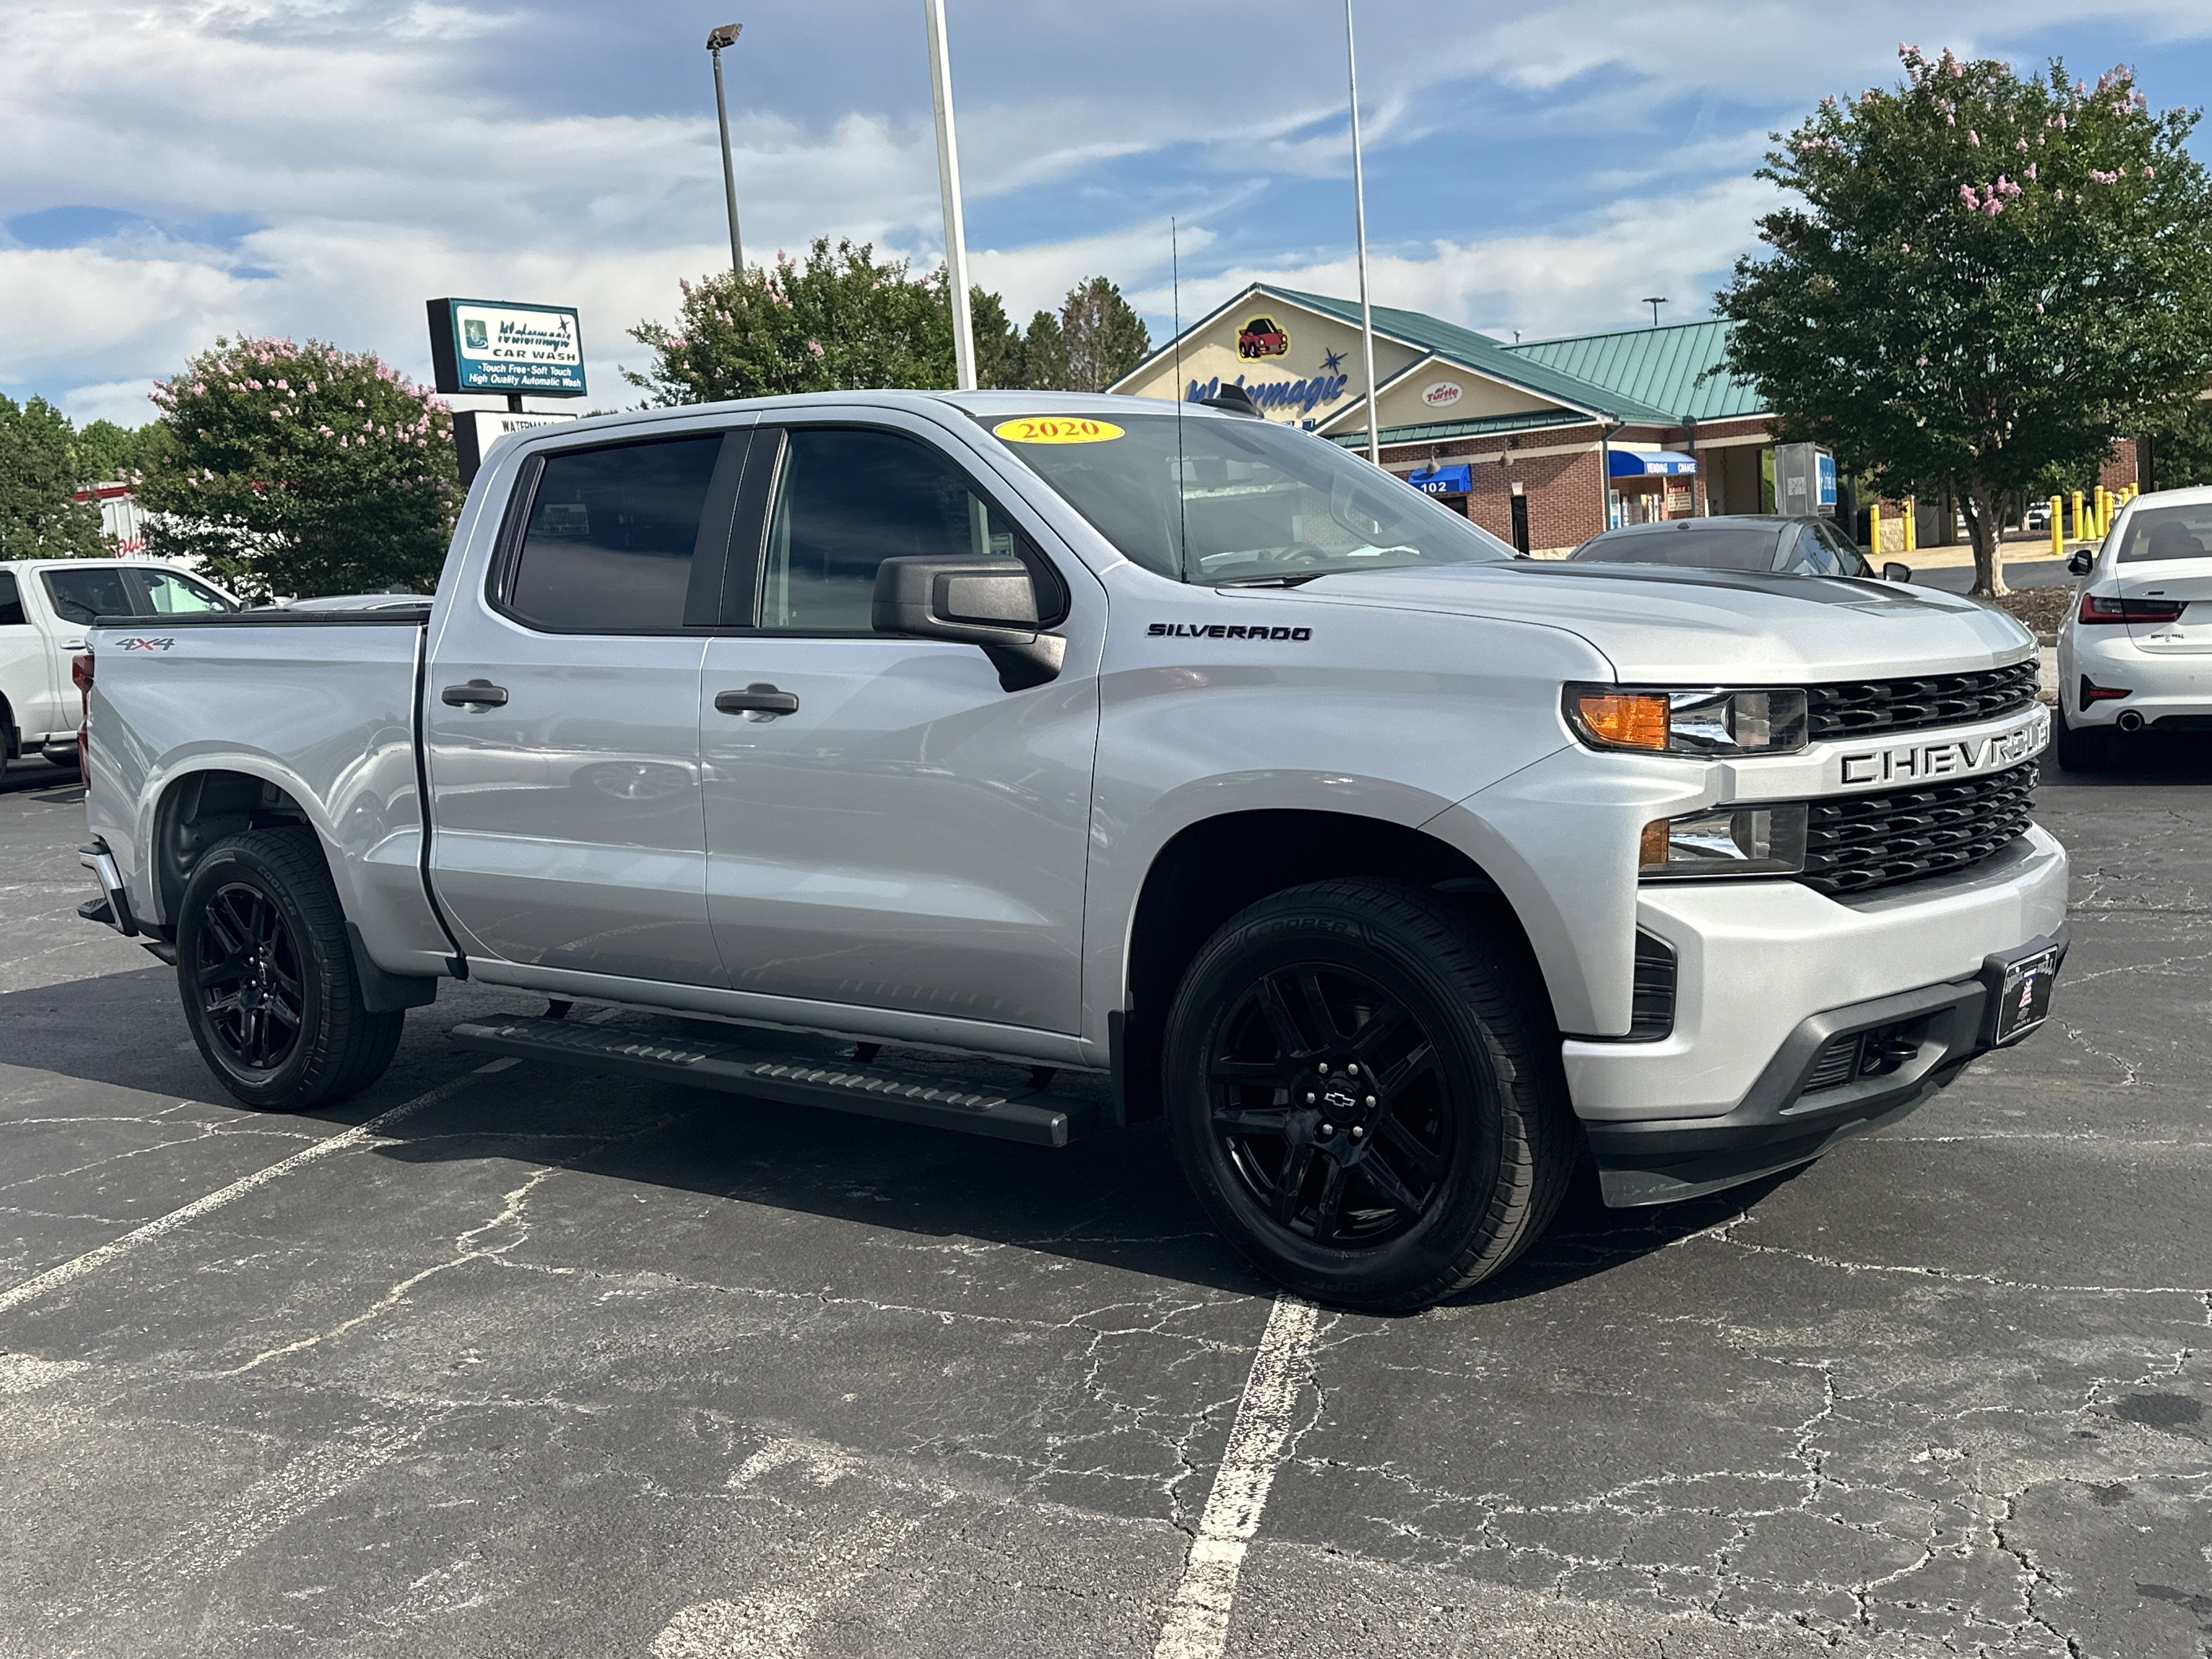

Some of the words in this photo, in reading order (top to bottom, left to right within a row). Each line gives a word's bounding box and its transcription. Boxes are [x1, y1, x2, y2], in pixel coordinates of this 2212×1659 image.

[498, 320, 571, 352] Watermagic
[493, 349, 526, 358] CAR
[532, 351, 575, 361] WASH
[482, 363, 506, 373] Touch
[509, 364, 526, 374] Free
[531, 365, 548, 375] Soft
[550, 367, 571, 376] Touch
[469, 374, 488, 385] High
[490, 374, 519, 386] Quality
[521, 376, 560, 386] Automatic
[562, 379, 581, 387] Wash
[1188, 374, 1348, 411] Wermagic
[1427, 387, 1458, 402] Turtle
[1018, 421, 1099, 438] 2020
[1421, 482, 1447, 493] 102
[1147, 624, 1312, 640] SILVERADO
[1841, 715, 2051, 787] CHEVROLET
[257, 866, 296, 915] COOPER
